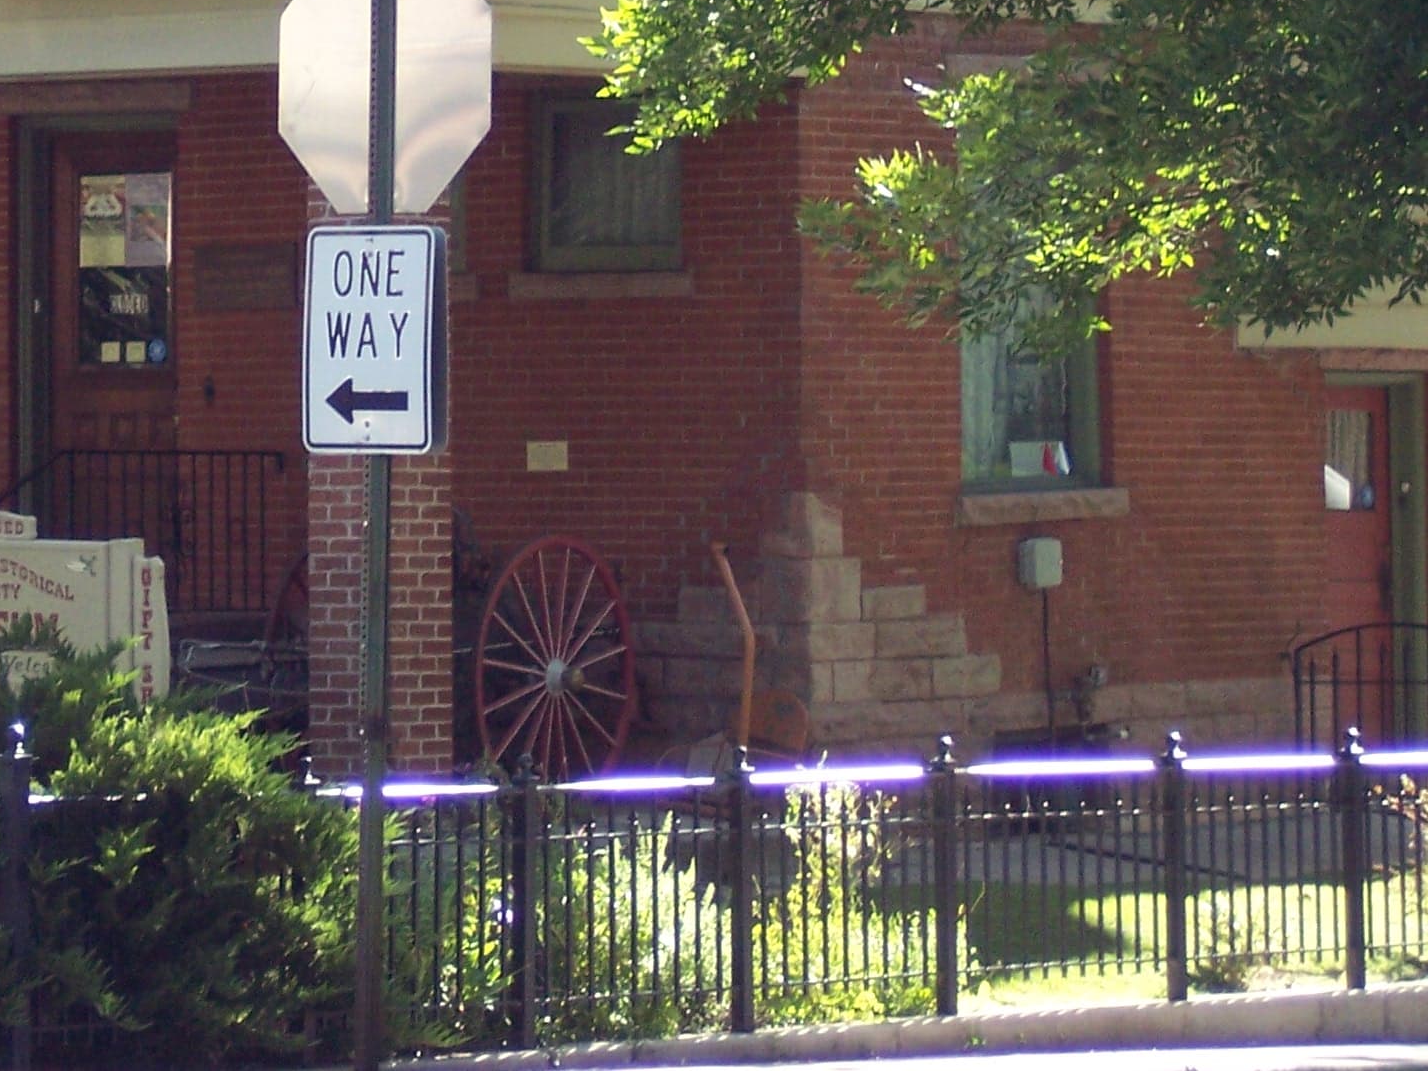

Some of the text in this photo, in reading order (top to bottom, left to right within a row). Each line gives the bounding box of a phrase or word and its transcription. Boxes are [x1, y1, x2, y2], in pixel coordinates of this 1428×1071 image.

[334, 250, 405, 297] ONE
[326, 311, 409, 358] WAY
[140, 567, 153, 650] GIFT
